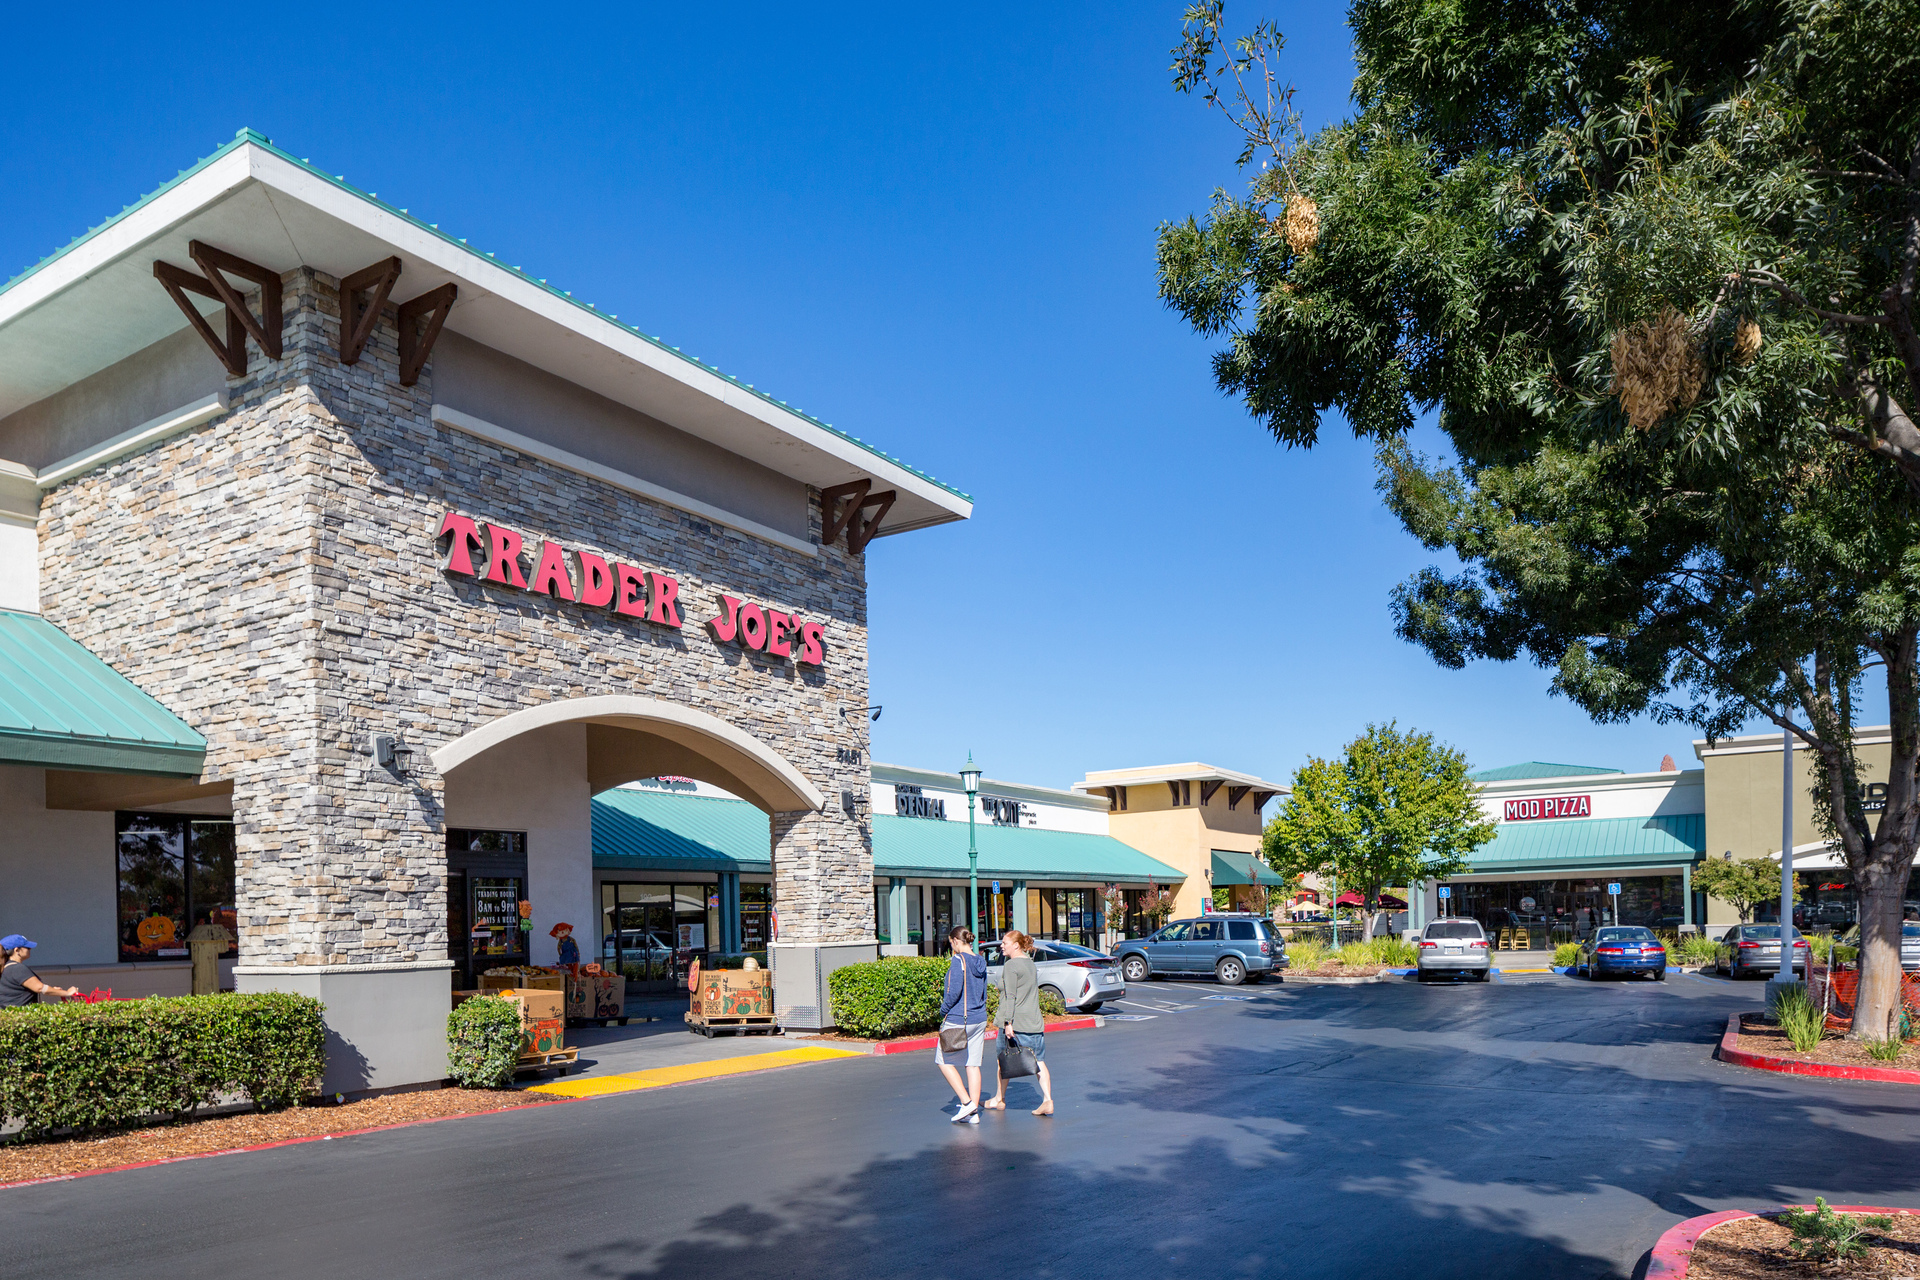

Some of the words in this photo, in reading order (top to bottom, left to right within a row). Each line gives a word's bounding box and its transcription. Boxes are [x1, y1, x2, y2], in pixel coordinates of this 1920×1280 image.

[433, 512, 682, 628] TRADER
[705, 594, 825, 665] JOE'S
[895, 795, 947, 820] DENTAL
[1506, 801, 1540, 820] MOD
[1544, 797, 1589, 817] PIZZA
[477, 890, 499, 898] TRADING
[499, 890, 515, 898] HOURS
[477, 900, 493, 913] 8AM
[501, 900, 515, 912] 9PM
[482, 916, 496, 924] DAYS
[497, 916, 501, 924] A
[502, 916, 516, 924] WEEK
